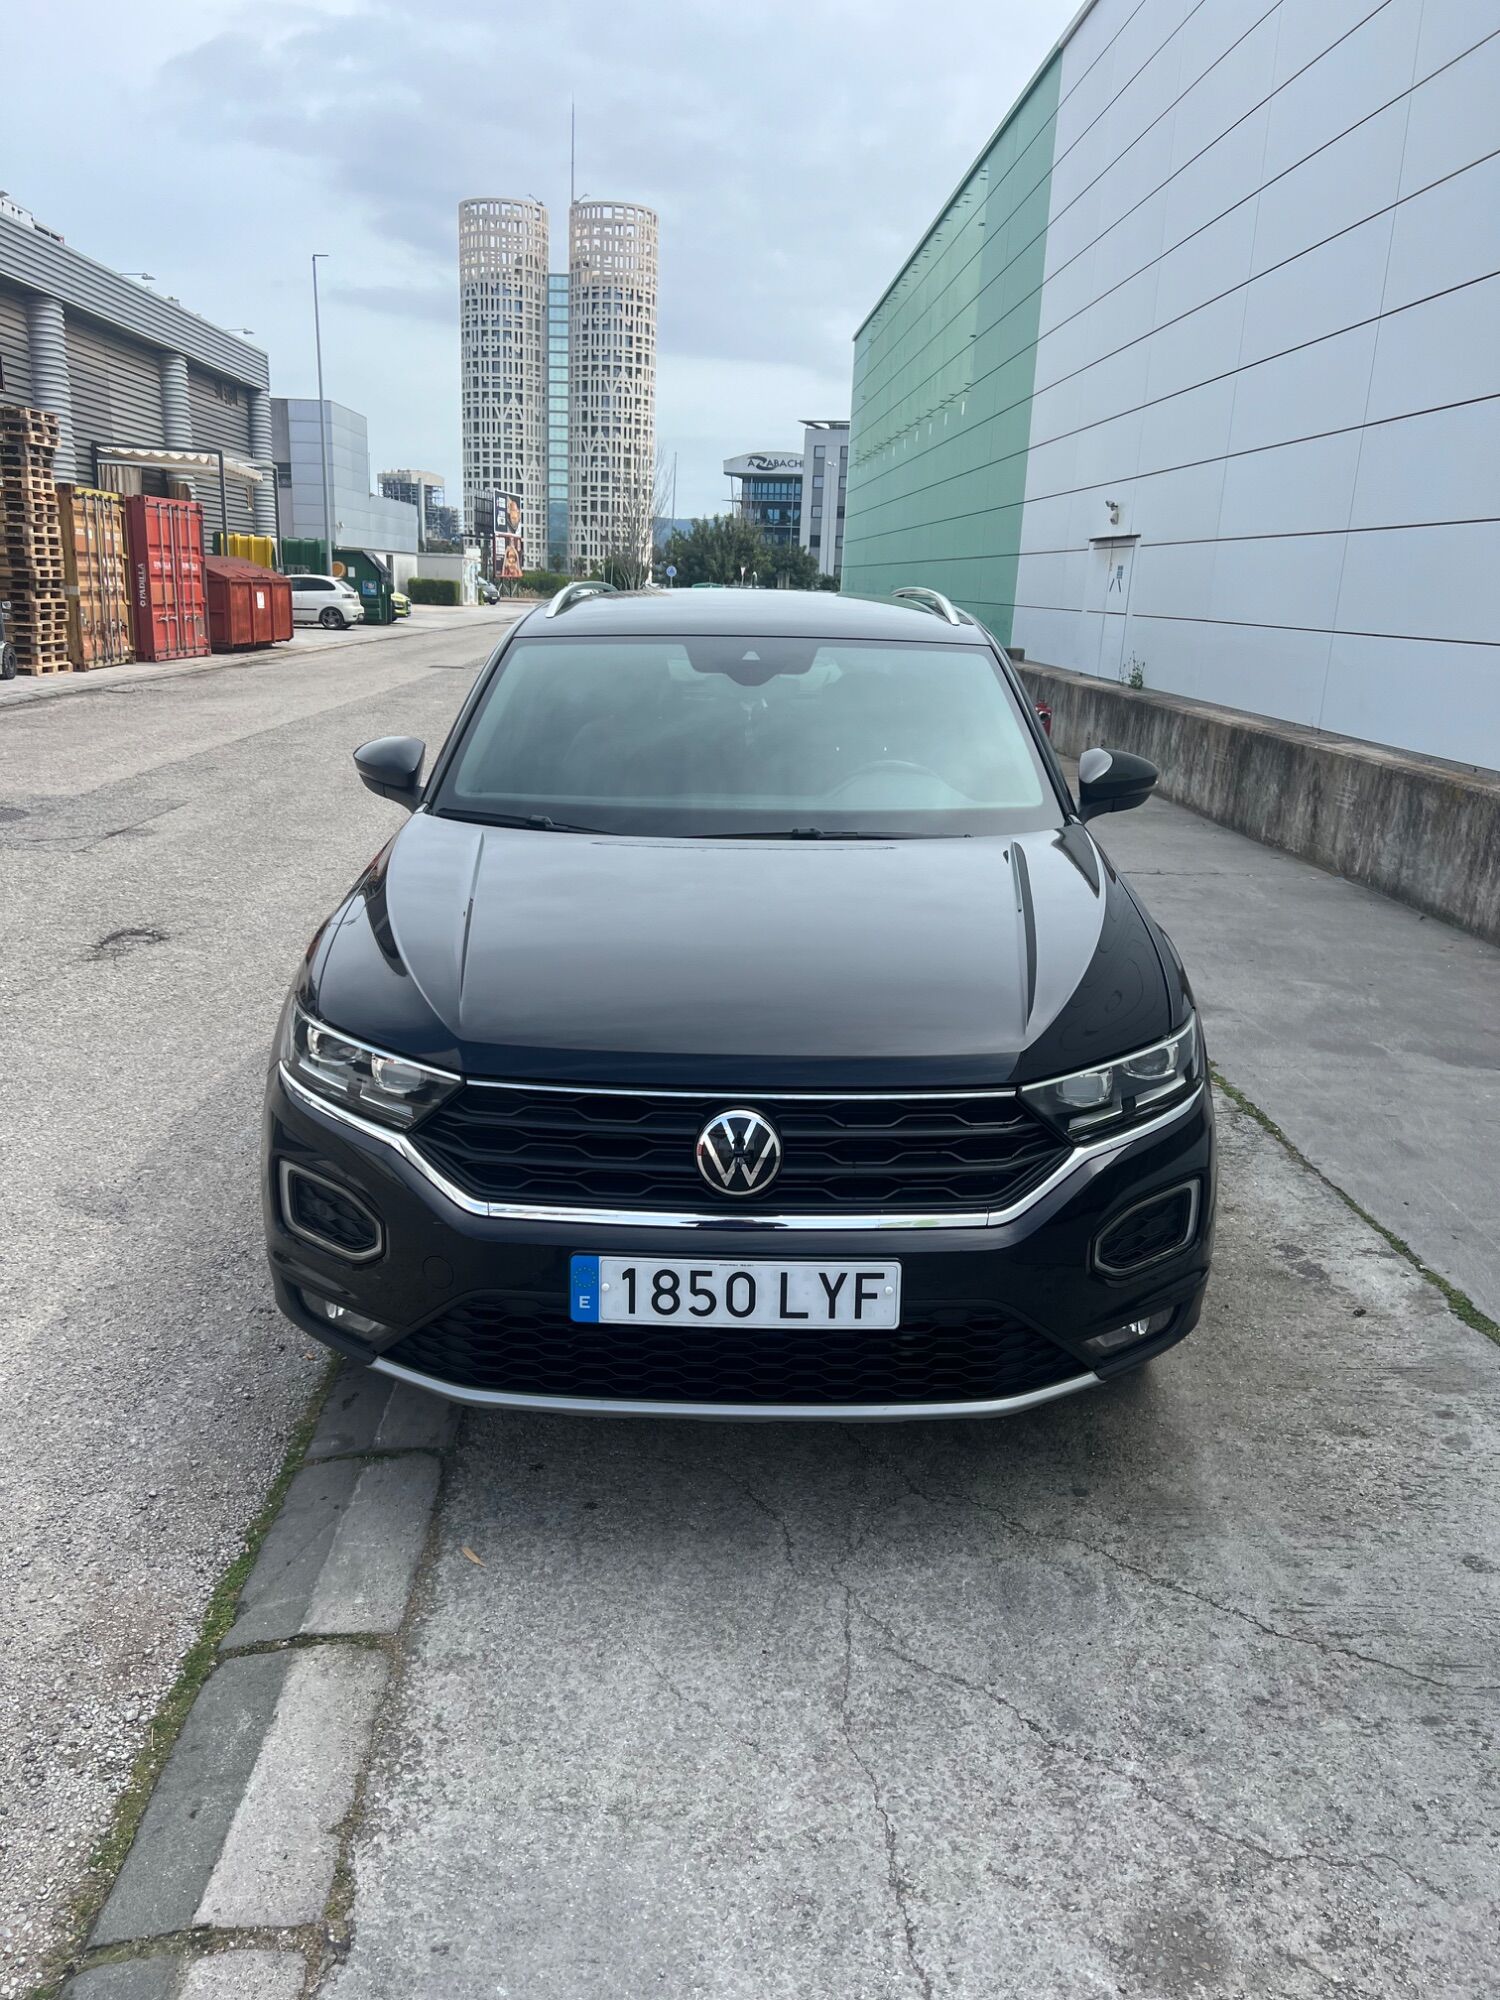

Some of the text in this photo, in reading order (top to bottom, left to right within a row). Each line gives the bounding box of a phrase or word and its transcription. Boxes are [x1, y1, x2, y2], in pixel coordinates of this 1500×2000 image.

[699, 1112, 779, 1192] VW
[578, 1295, 591, 1309] E
[621, 1267, 886, 1320] 1850 LYF
